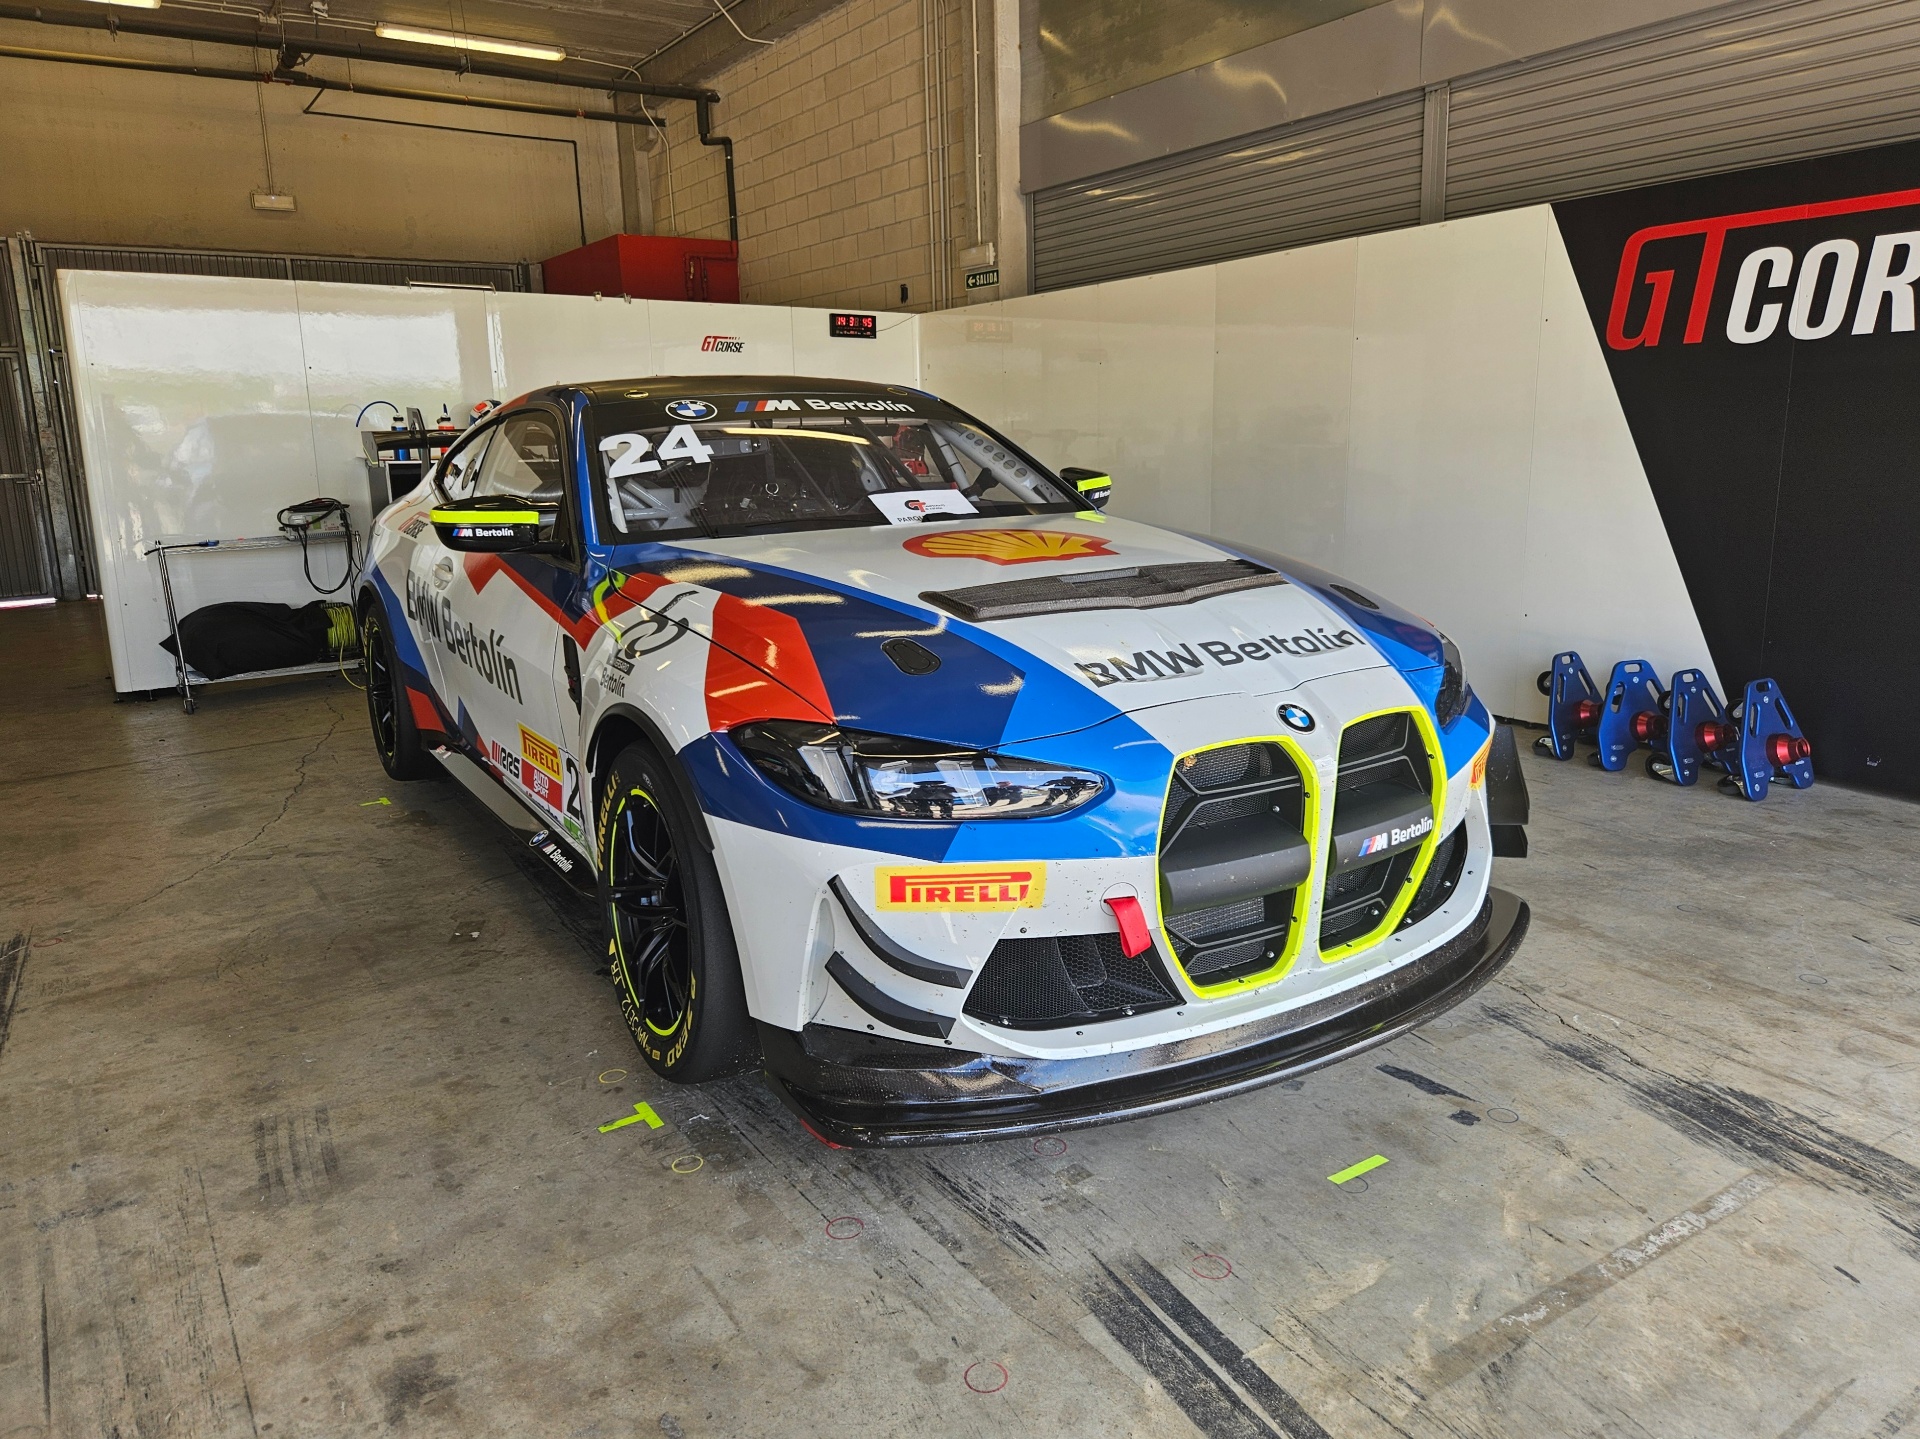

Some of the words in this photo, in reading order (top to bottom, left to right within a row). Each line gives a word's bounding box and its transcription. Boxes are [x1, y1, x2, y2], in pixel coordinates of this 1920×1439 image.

[975, 271, 998, 286] SALIDA
[715, 340, 745, 353] CORSE
[803, 398, 916, 413] Bertolín
[598, 423, 715, 479] 24
[475, 527, 515, 537] Bertolín
[406, 569, 442, 643] BMW
[441, 595, 524, 706] Bertolín
[1074, 642, 1205, 688] BMW
[520, 728, 561, 777] PIRELLI
[533, 769, 549, 789] AUTO
[533, 782, 549, 799] SPORT
[597, 774, 618, 872] PIRELLI
[1391, 816, 1433, 846] Bertolín
[549, 848, 574, 873] Bertolín
[889, 871, 1033, 903] PIRELLI
